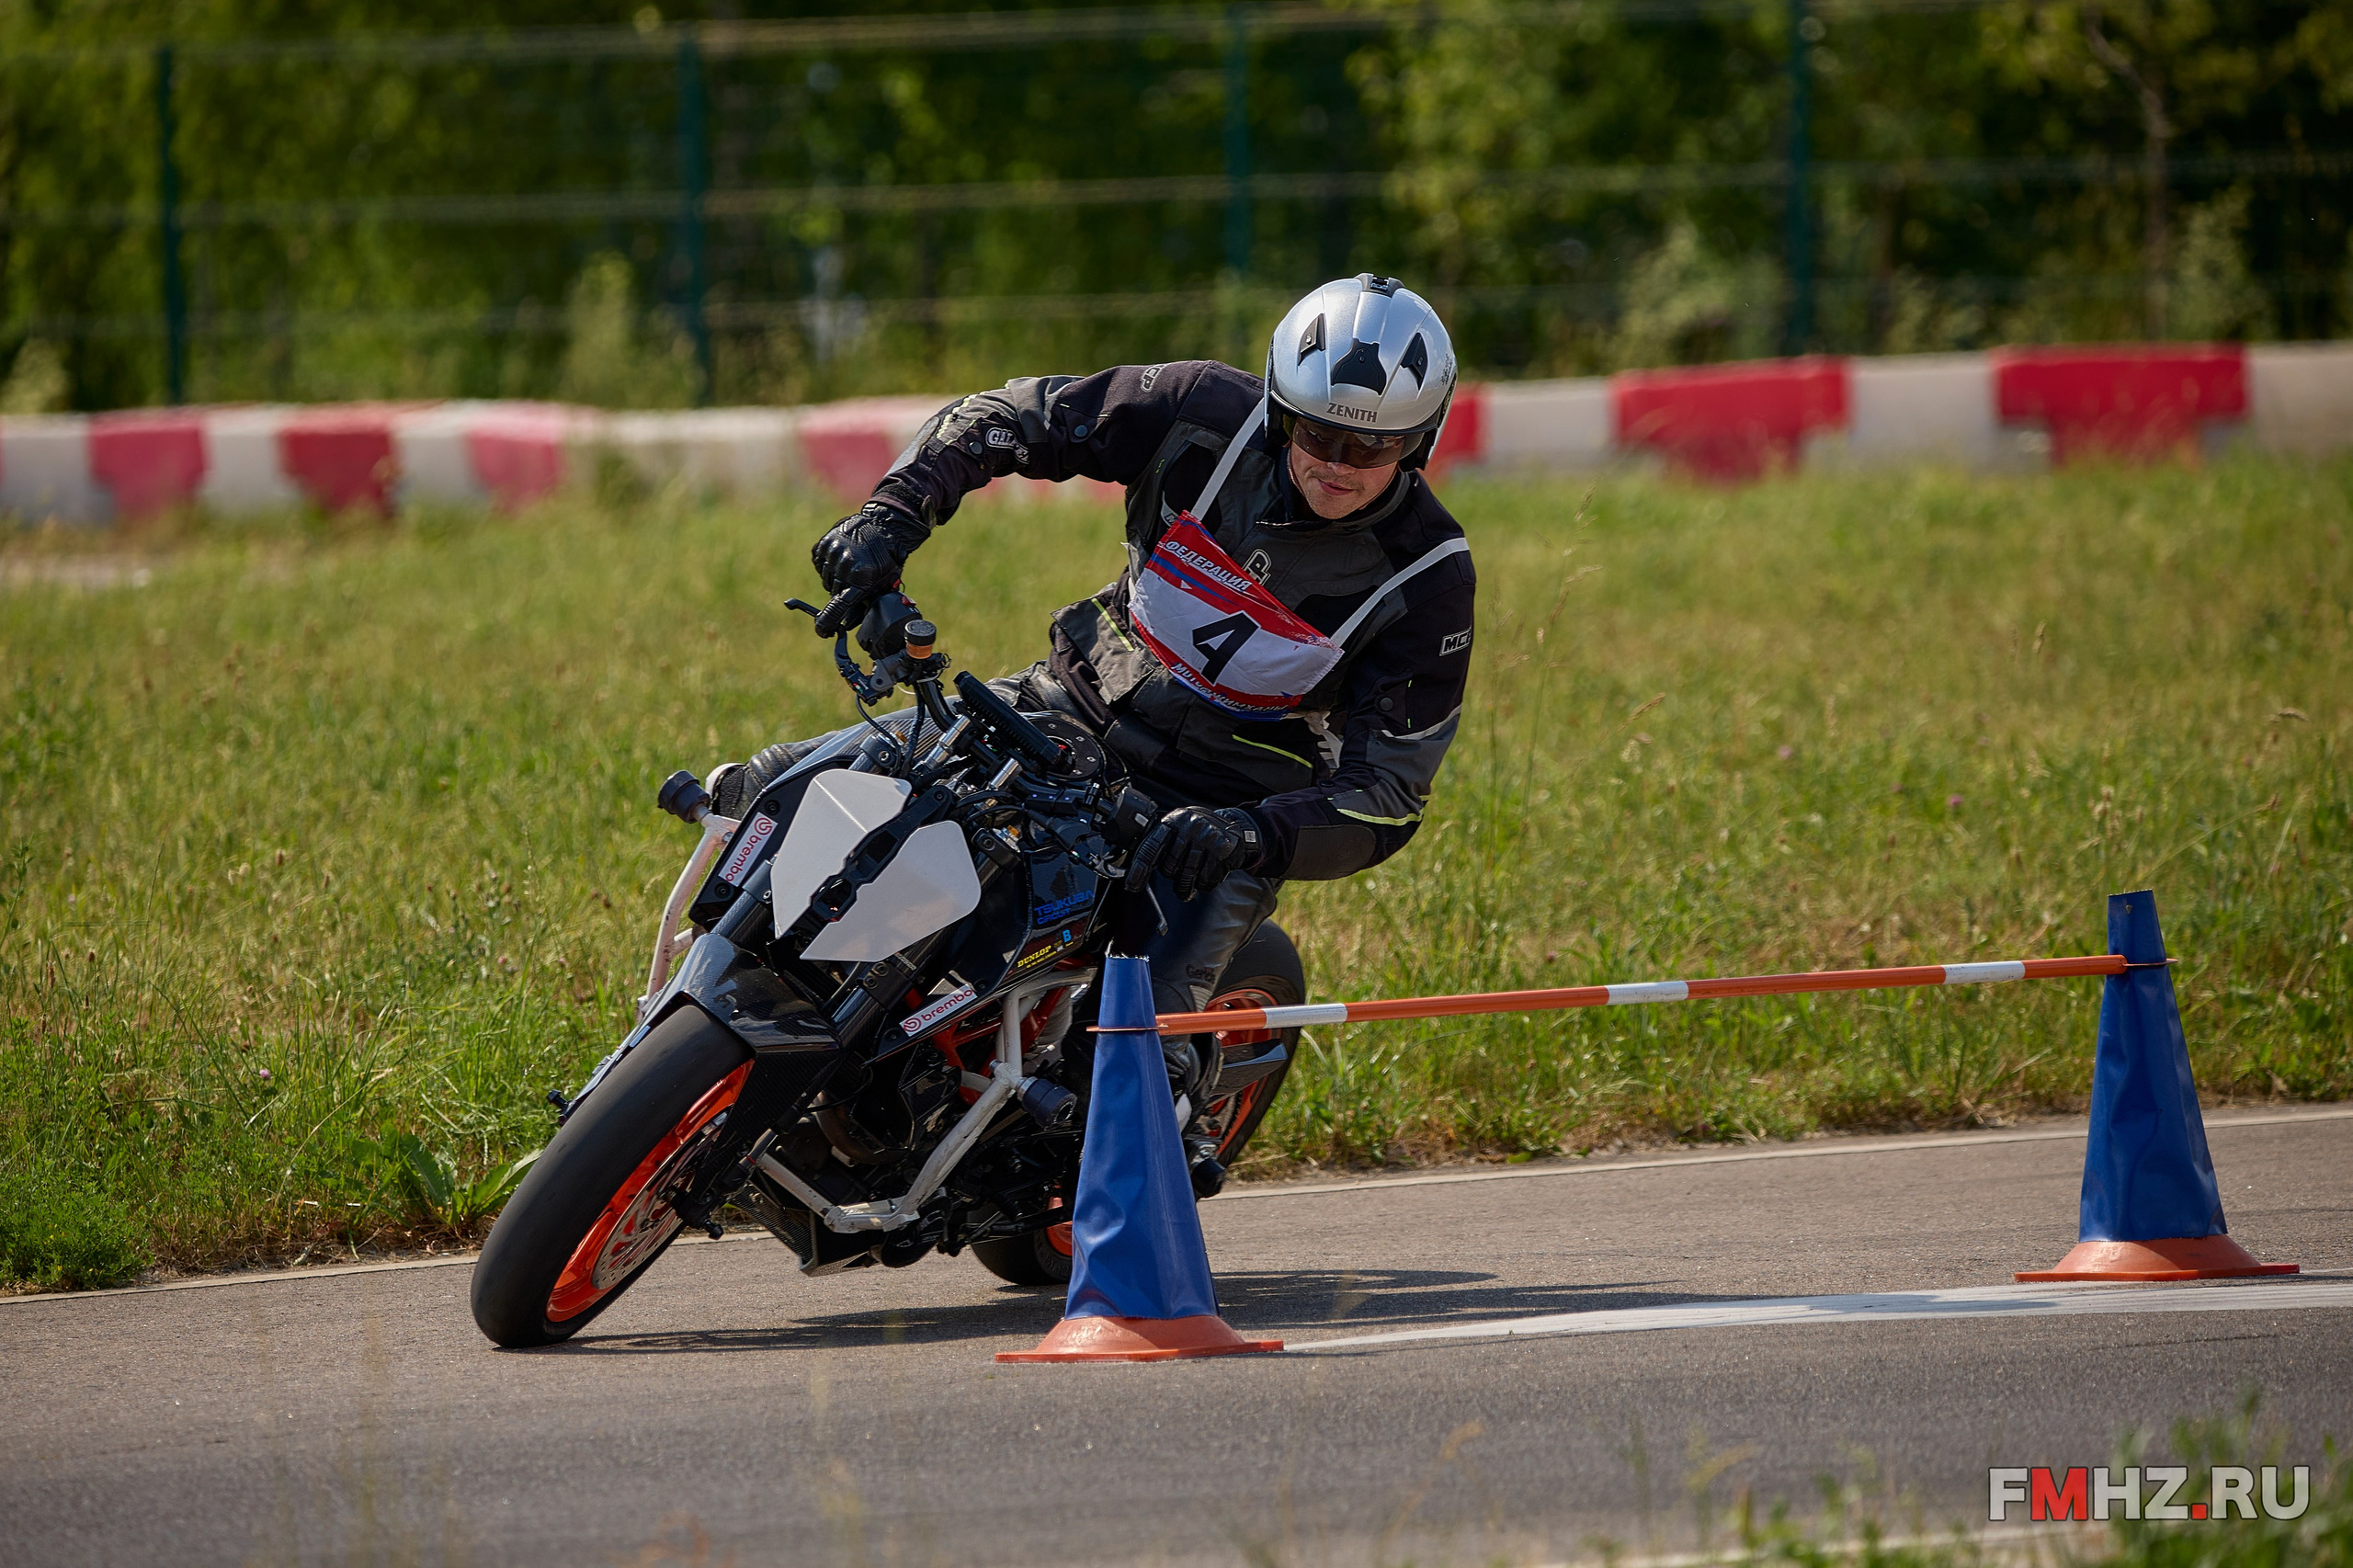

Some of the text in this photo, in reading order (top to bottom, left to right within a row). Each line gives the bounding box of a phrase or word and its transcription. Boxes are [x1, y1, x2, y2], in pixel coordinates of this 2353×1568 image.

[1326, 403, 1378, 424] ZENITH
[1165, 540, 1253, 592] ФЕДЕРАЦИЯ
[1192, 610, 1262, 687] 4
[725, 835, 762, 882] brembo
[1034, 890, 1095, 916] TSUKUBA
[1017, 945, 1052, 968] DUNLOP
[921, 989, 973, 1022] brembo
